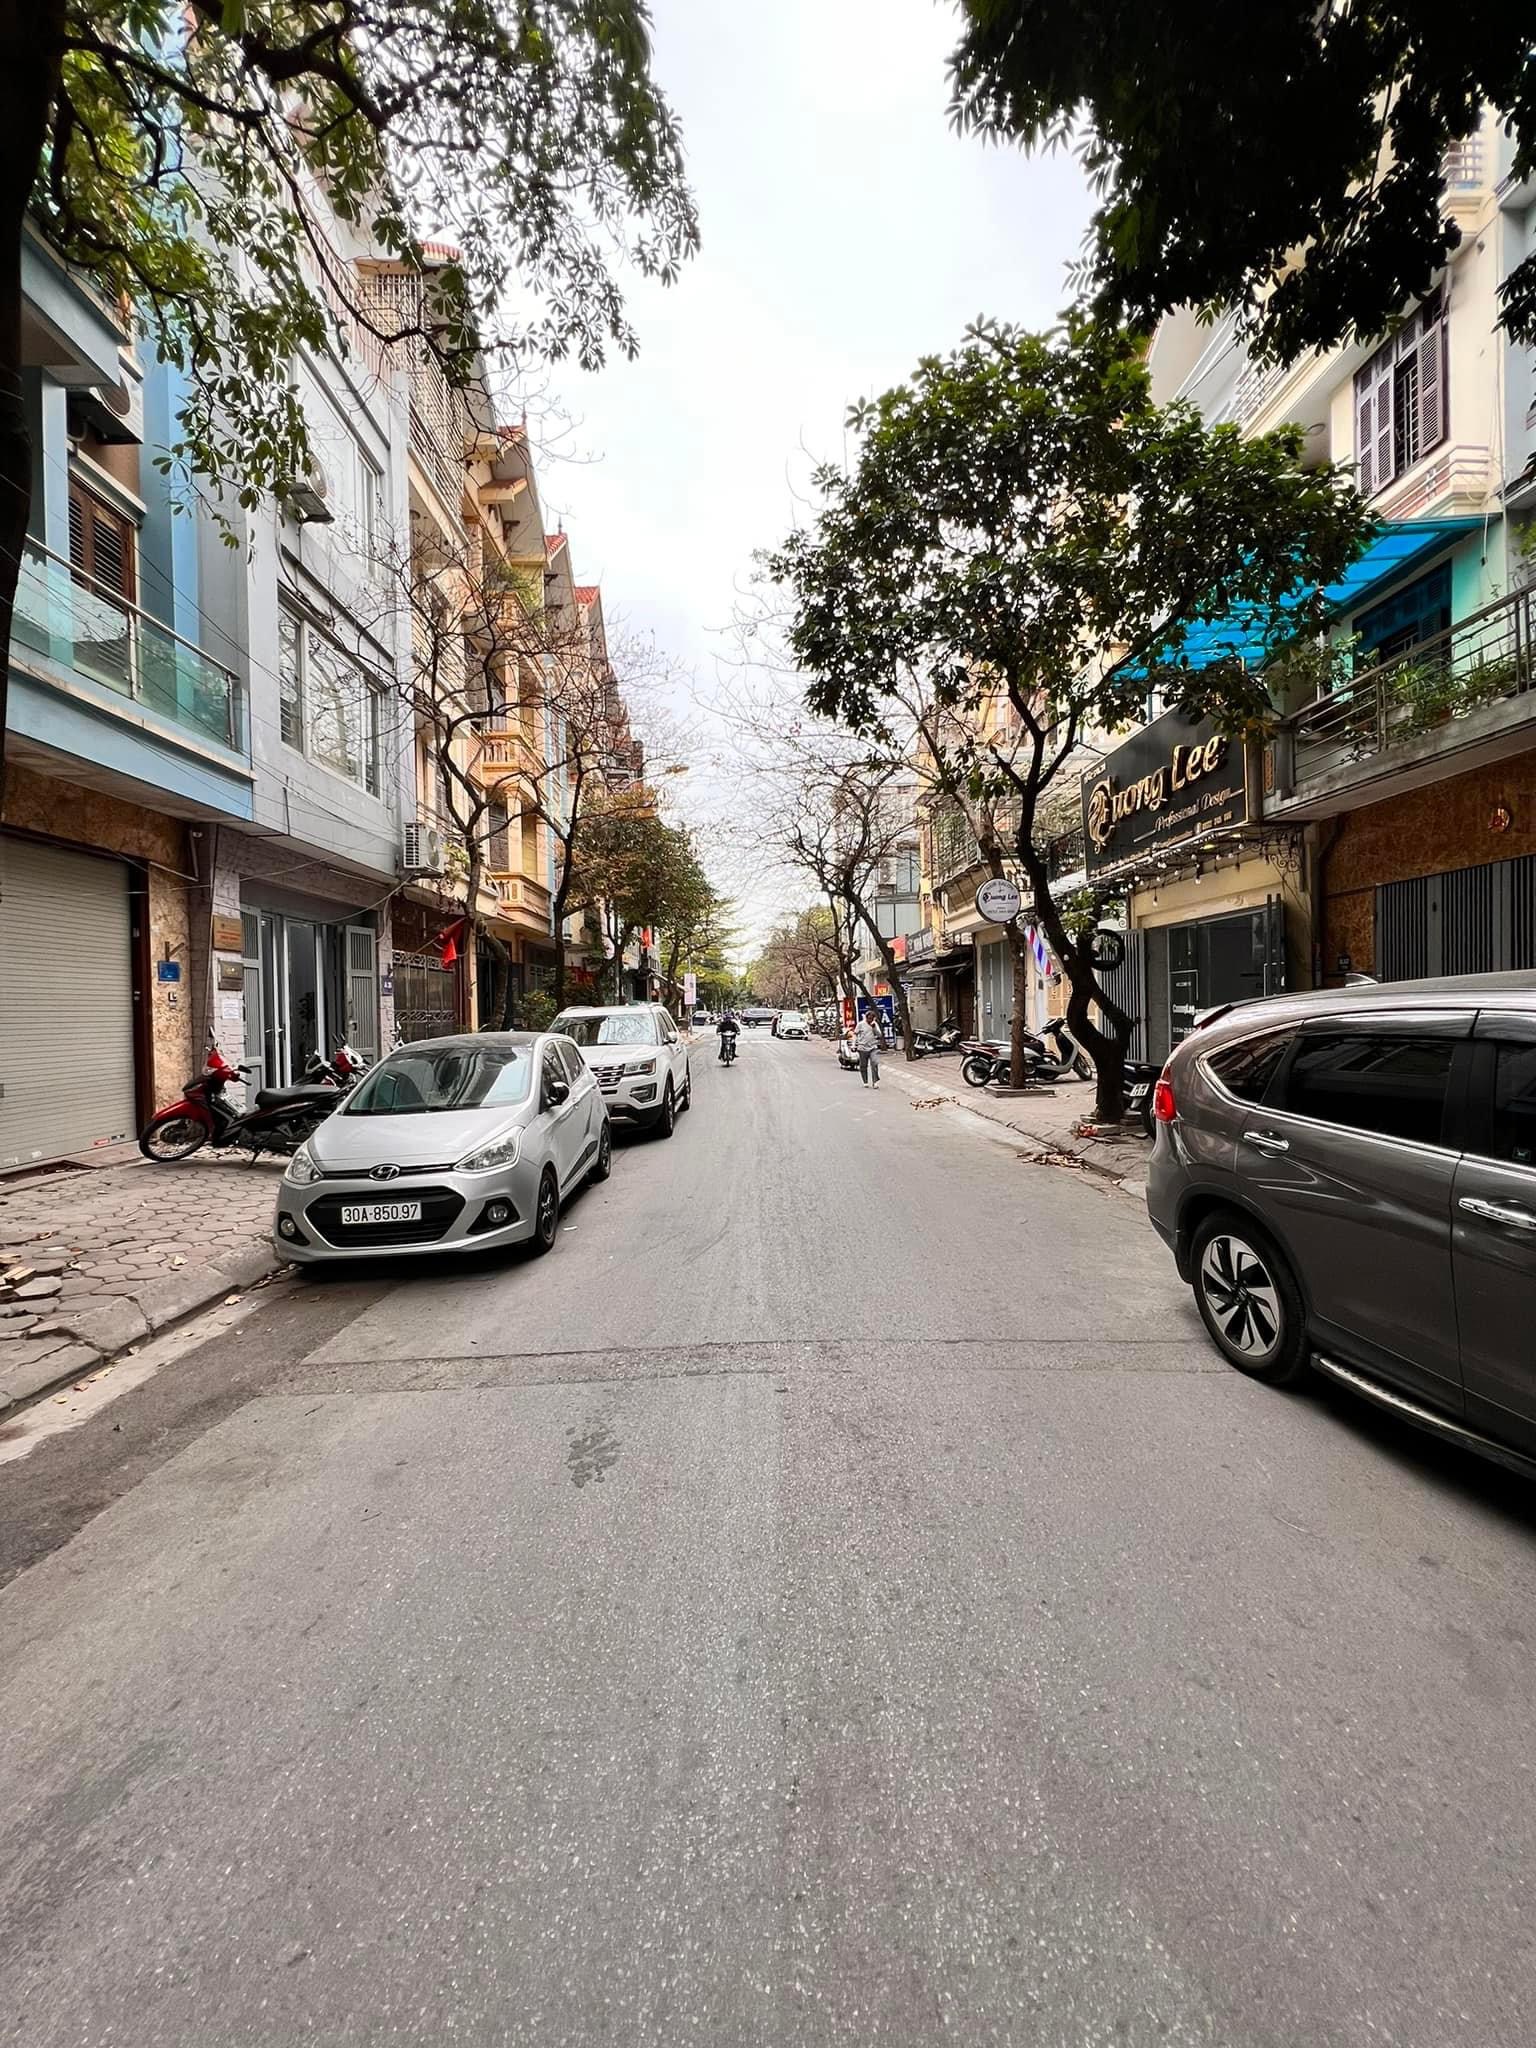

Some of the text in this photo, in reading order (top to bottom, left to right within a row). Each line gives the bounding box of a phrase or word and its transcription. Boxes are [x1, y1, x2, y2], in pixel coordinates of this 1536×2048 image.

[1172, 735, 1227, 791] Lee
[1155, 800, 1200, 832] Professional
[1201, 788, 1231, 812] Design
[344, 1204, 418, 1222] 30A-850.97
